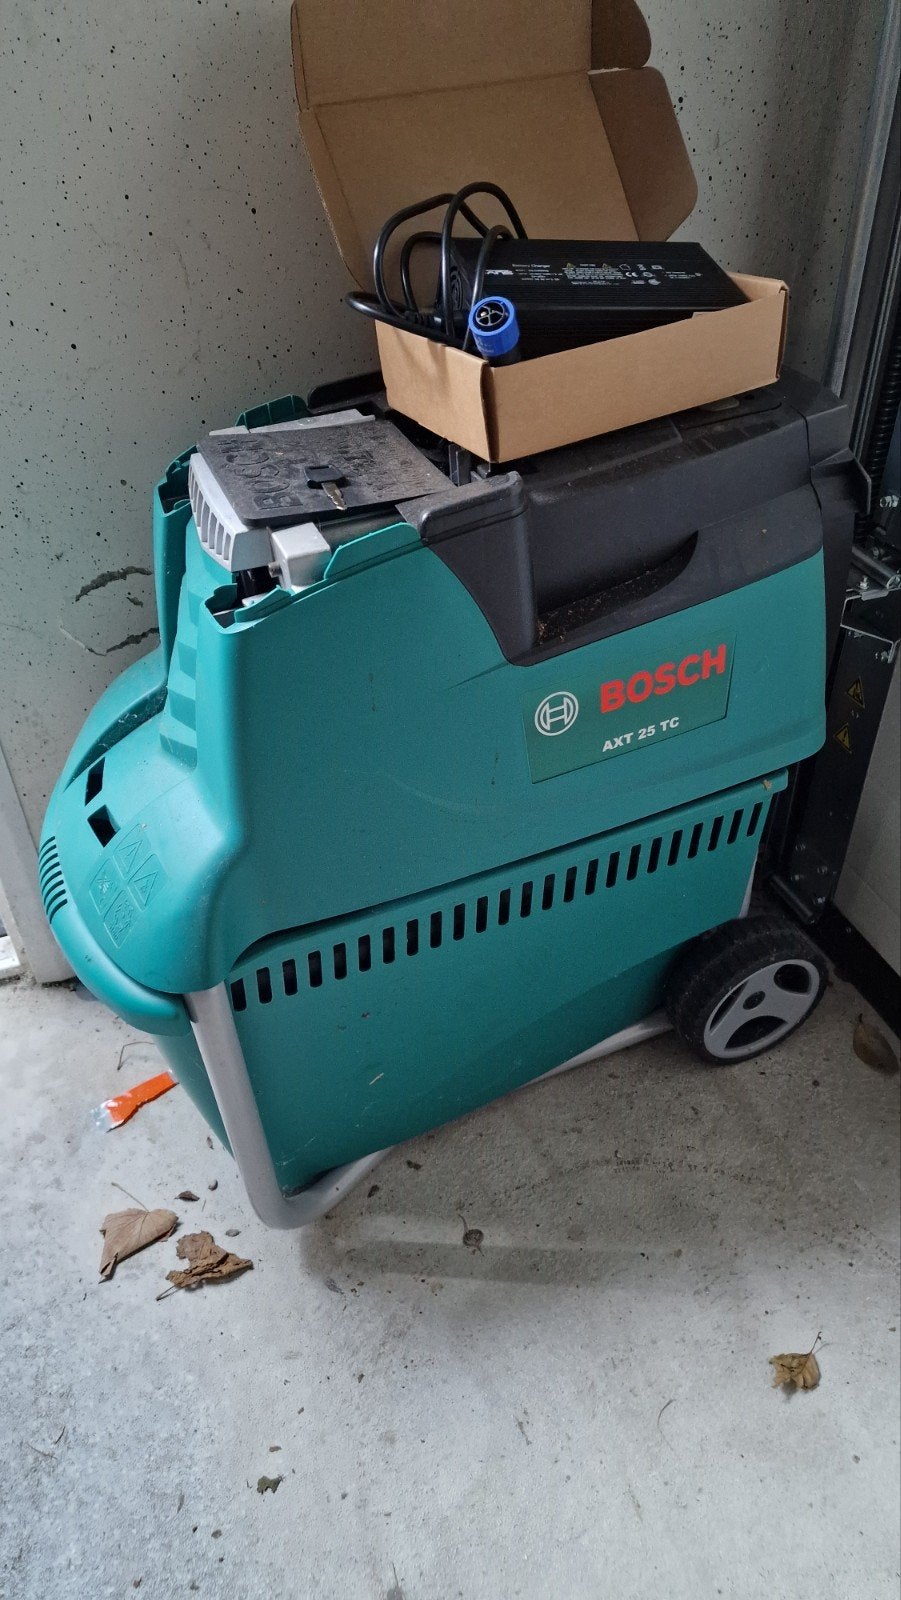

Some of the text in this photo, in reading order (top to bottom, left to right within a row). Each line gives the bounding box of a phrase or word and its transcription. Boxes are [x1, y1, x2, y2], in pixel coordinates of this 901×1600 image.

[600, 644, 727, 714] BOSCH
[602, 716, 680, 752] AXT 25 TC
